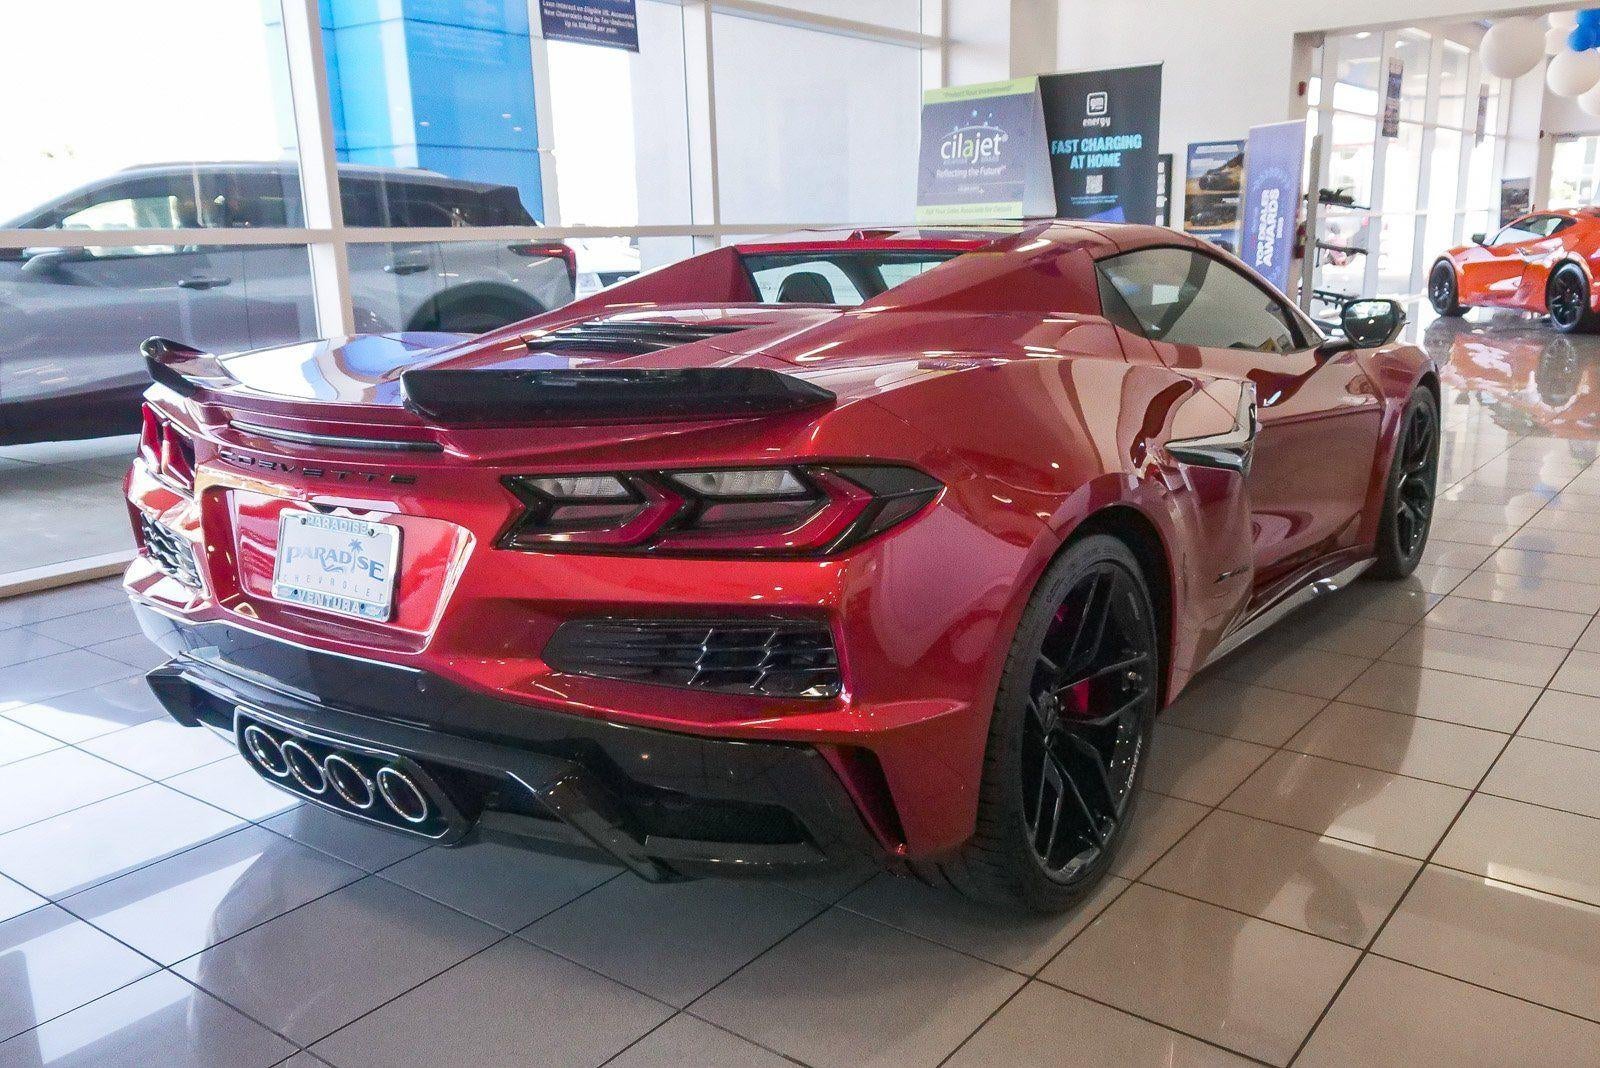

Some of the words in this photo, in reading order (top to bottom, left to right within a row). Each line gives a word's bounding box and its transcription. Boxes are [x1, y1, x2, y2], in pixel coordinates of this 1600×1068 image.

[1082, 117, 1111, 127] energy
[1051, 139, 1079, 155] FAST
[1081, 134, 1143, 152] CHARGING
[1070, 154, 1086, 169] AT
[1087, 152, 1122, 168] HOME
[1263, 188, 1280, 267] AWARDS
[219, 449, 417, 485] CORVETTE
[307, 515, 369, 534] PARADISE
[285, 545, 385, 582] PARADISE
[283, 573, 384, 601] CHEVROLET
[298, 589, 361, 614] VENTURA
